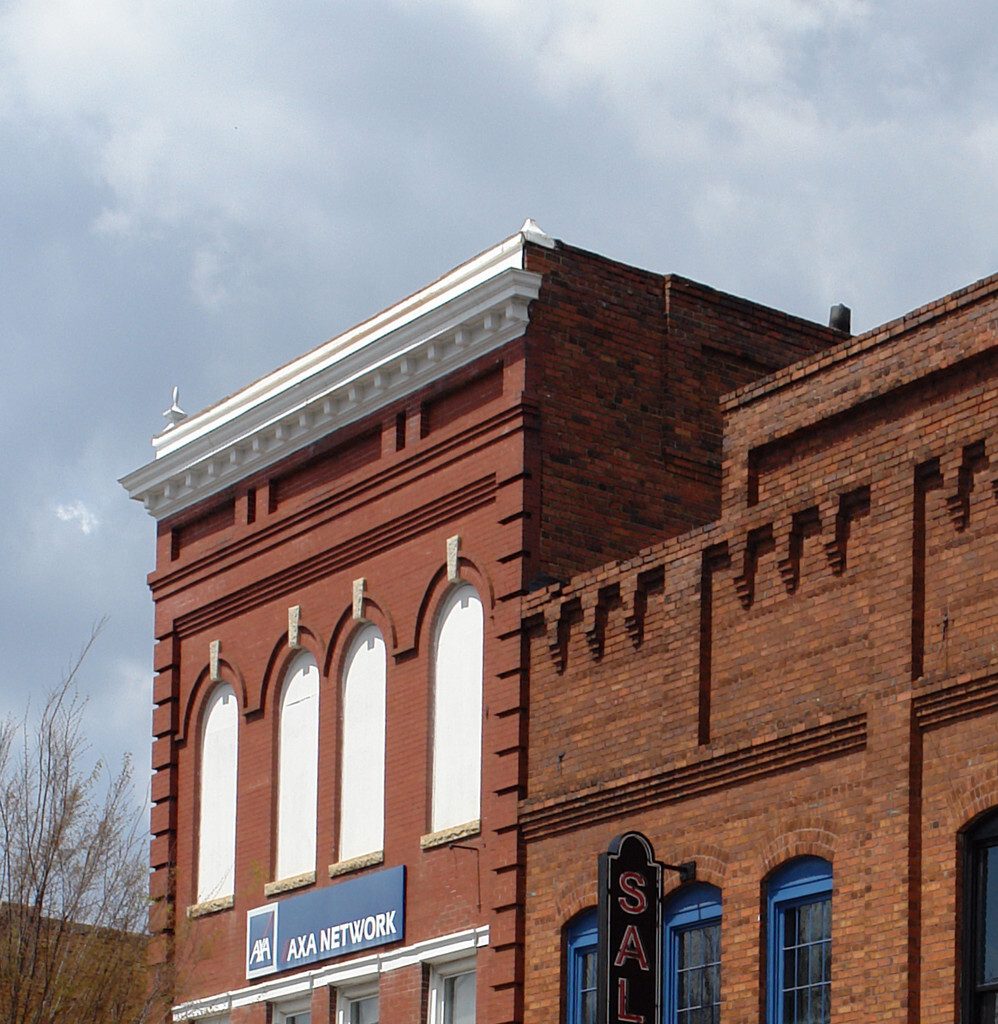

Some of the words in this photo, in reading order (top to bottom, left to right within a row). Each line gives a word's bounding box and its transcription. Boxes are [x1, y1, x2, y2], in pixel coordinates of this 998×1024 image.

[250, 936, 272, 965] AXA
[287, 933, 317, 961] AXA
[320, 910, 397, 952] NETWORK
